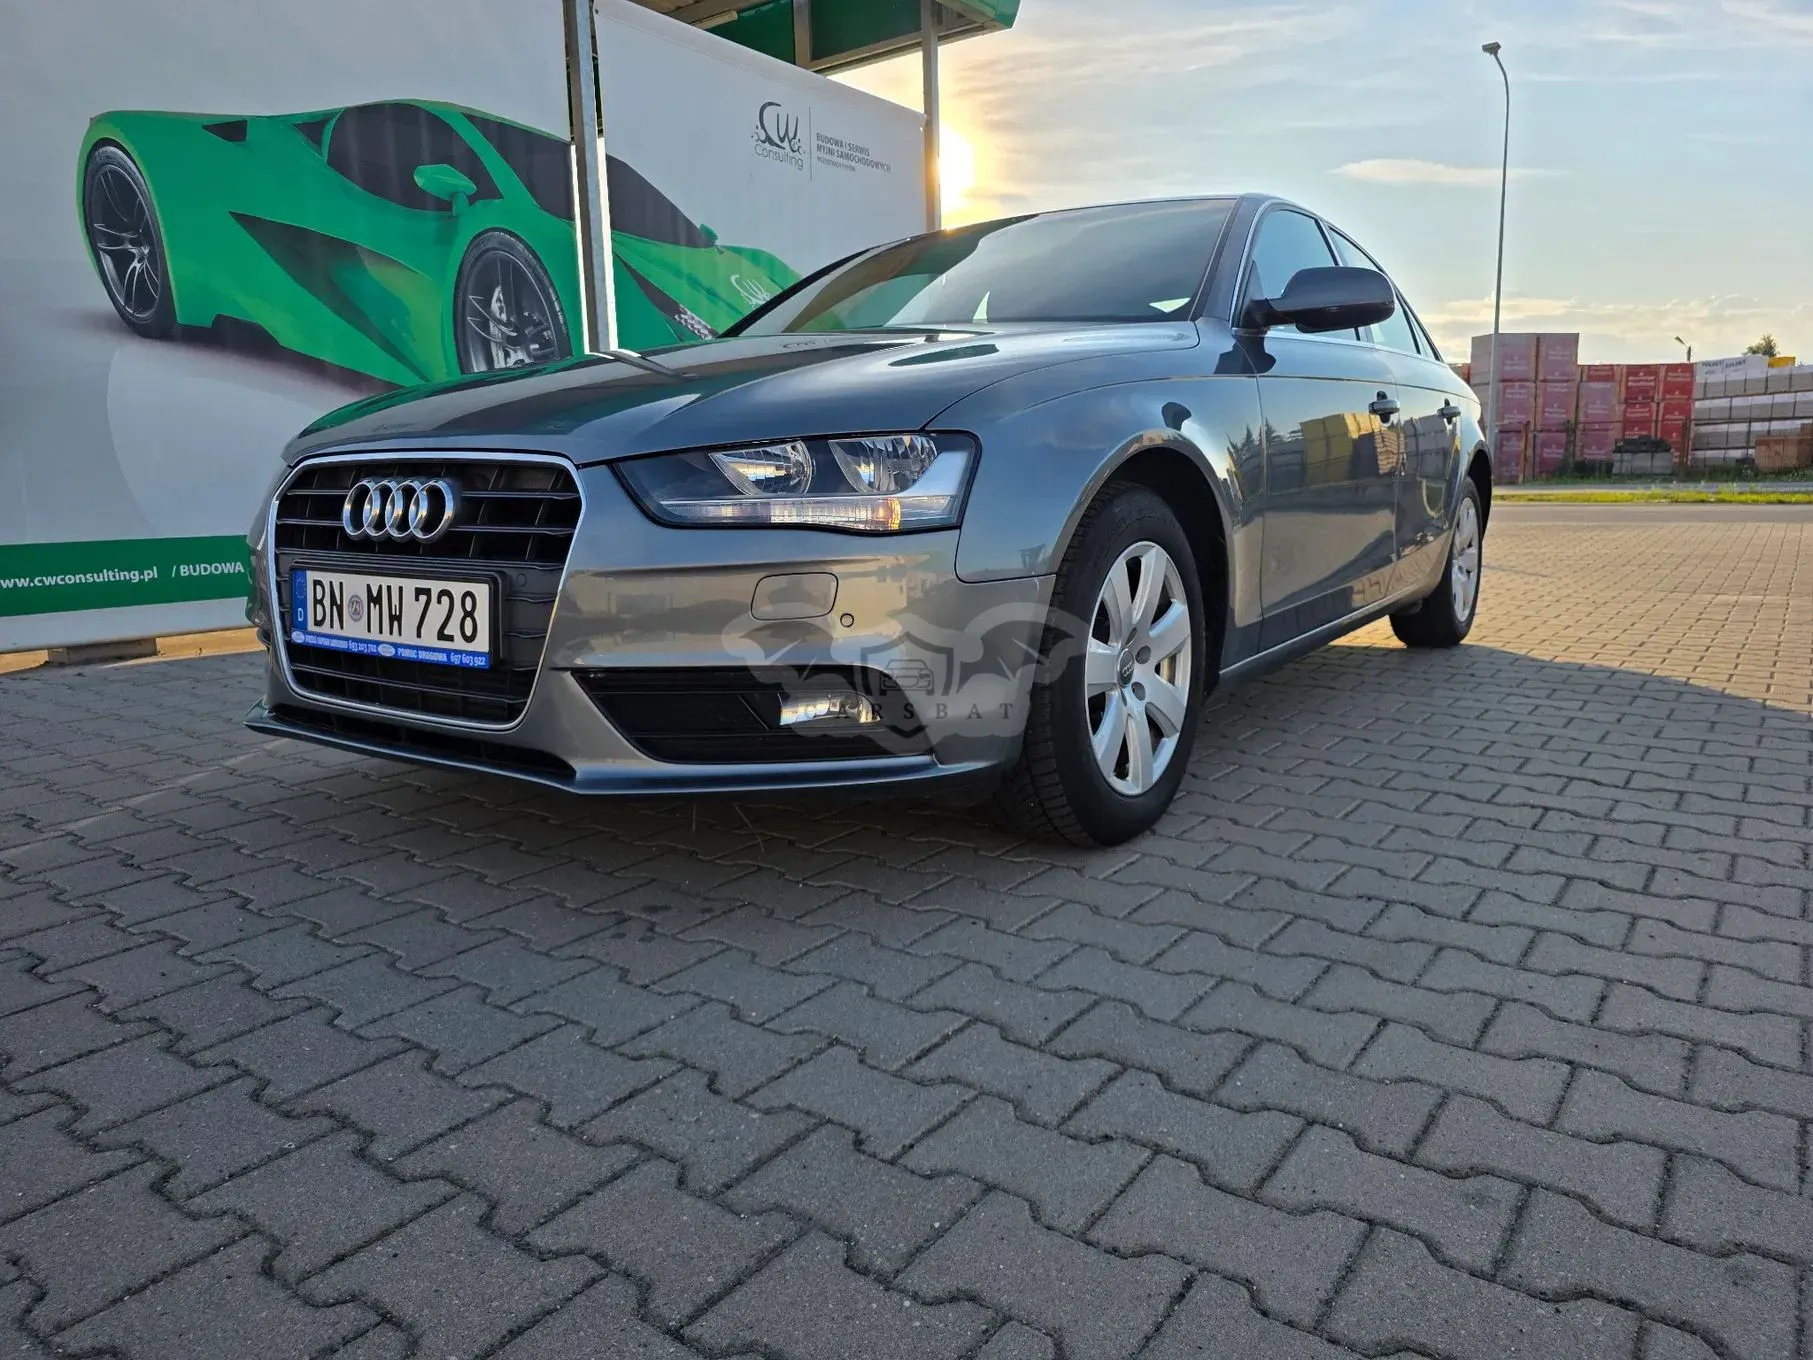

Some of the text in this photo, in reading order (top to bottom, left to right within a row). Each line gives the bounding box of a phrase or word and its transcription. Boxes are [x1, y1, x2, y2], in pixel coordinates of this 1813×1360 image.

[816, 132, 844, 148] BUDOWA
[848, 142, 870, 157] SERWIS
[816, 143, 836, 157] MYJNI
[836, 150, 891, 173] SAMOCHODOWYCH
[180, 561, 245, 577] BUDOWA
[297, 607, 304, 622] D
[312, 579, 478, 644] BN MW 728
